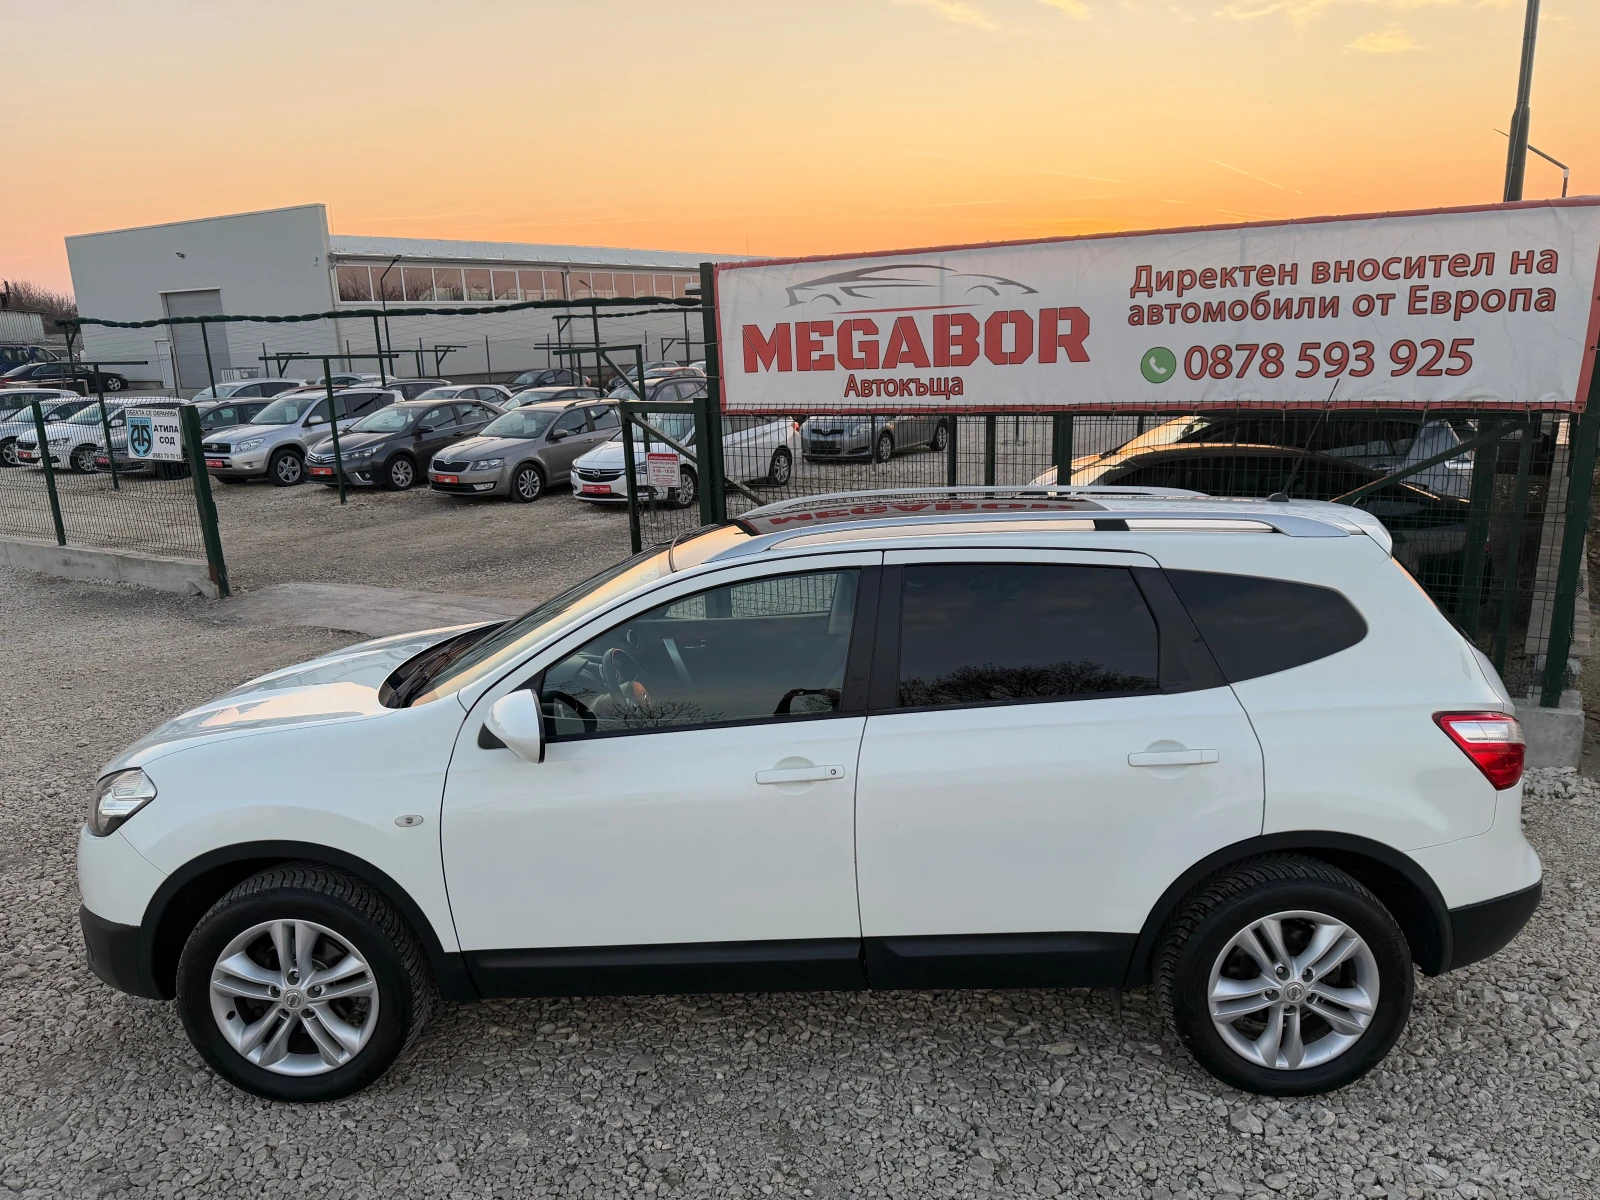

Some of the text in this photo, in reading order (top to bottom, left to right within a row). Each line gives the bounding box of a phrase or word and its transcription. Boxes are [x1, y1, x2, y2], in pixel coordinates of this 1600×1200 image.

[1129, 248, 1559, 299] Директен вносител на
[1127, 284, 1557, 326] автомобили от Европа
[742, 306, 1091, 373] MEGABOR
[1184, 338, 1475, 380] 0878 593 925
[844, 373, 964, 400] Автокъща
[153, 424, 179, 433] АТИЛА
[159, 436, 176, 446] СОД
